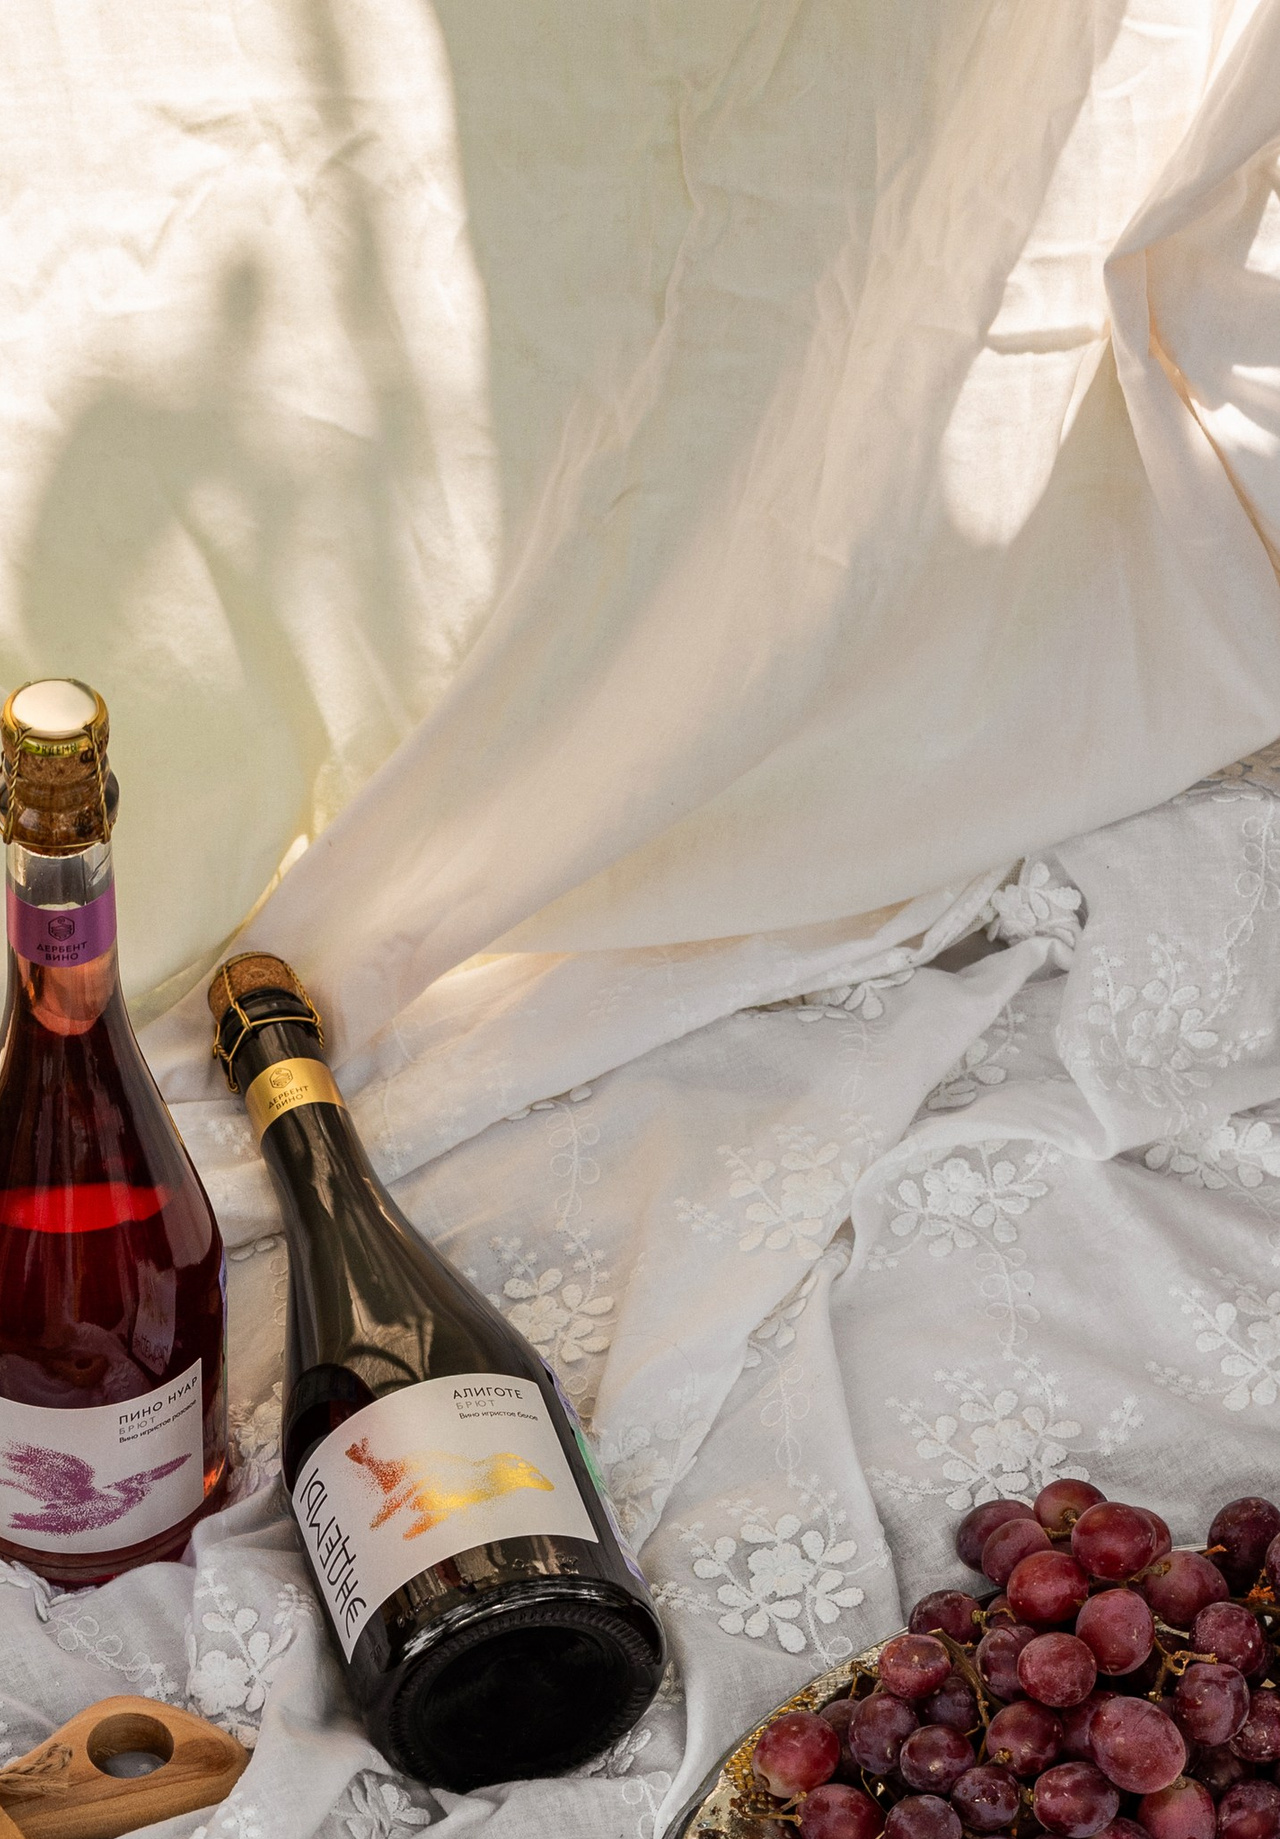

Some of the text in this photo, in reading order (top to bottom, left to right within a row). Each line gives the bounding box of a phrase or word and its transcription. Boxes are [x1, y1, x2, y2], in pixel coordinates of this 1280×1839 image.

[36, 940, 89, 953] ДЕРБЕНТ
[45, 952, 79, 961] ВИНО
[268, 1085, 309, 1110] ДЕРБЕНТ
[275, 1093, 304, 1110] ВИНО
[119, 1376, 198, 1425] ПИНО НУАР
[453, 1386, 524, 1400] АЛИГОТЕ
[456, 1399, 495, 1410] БРЮТ
[459, 1411, 480, 1420] Вино
[481, 1410, 517, 1418] игристое
[119, 1416, 156, 1435] БРЮТ
[119, 1433, 139, 1443] Вино
[139, 1417, 172, 1436] игристое
[299, 1467, 367, 1640] ЭНДЕМЫ
